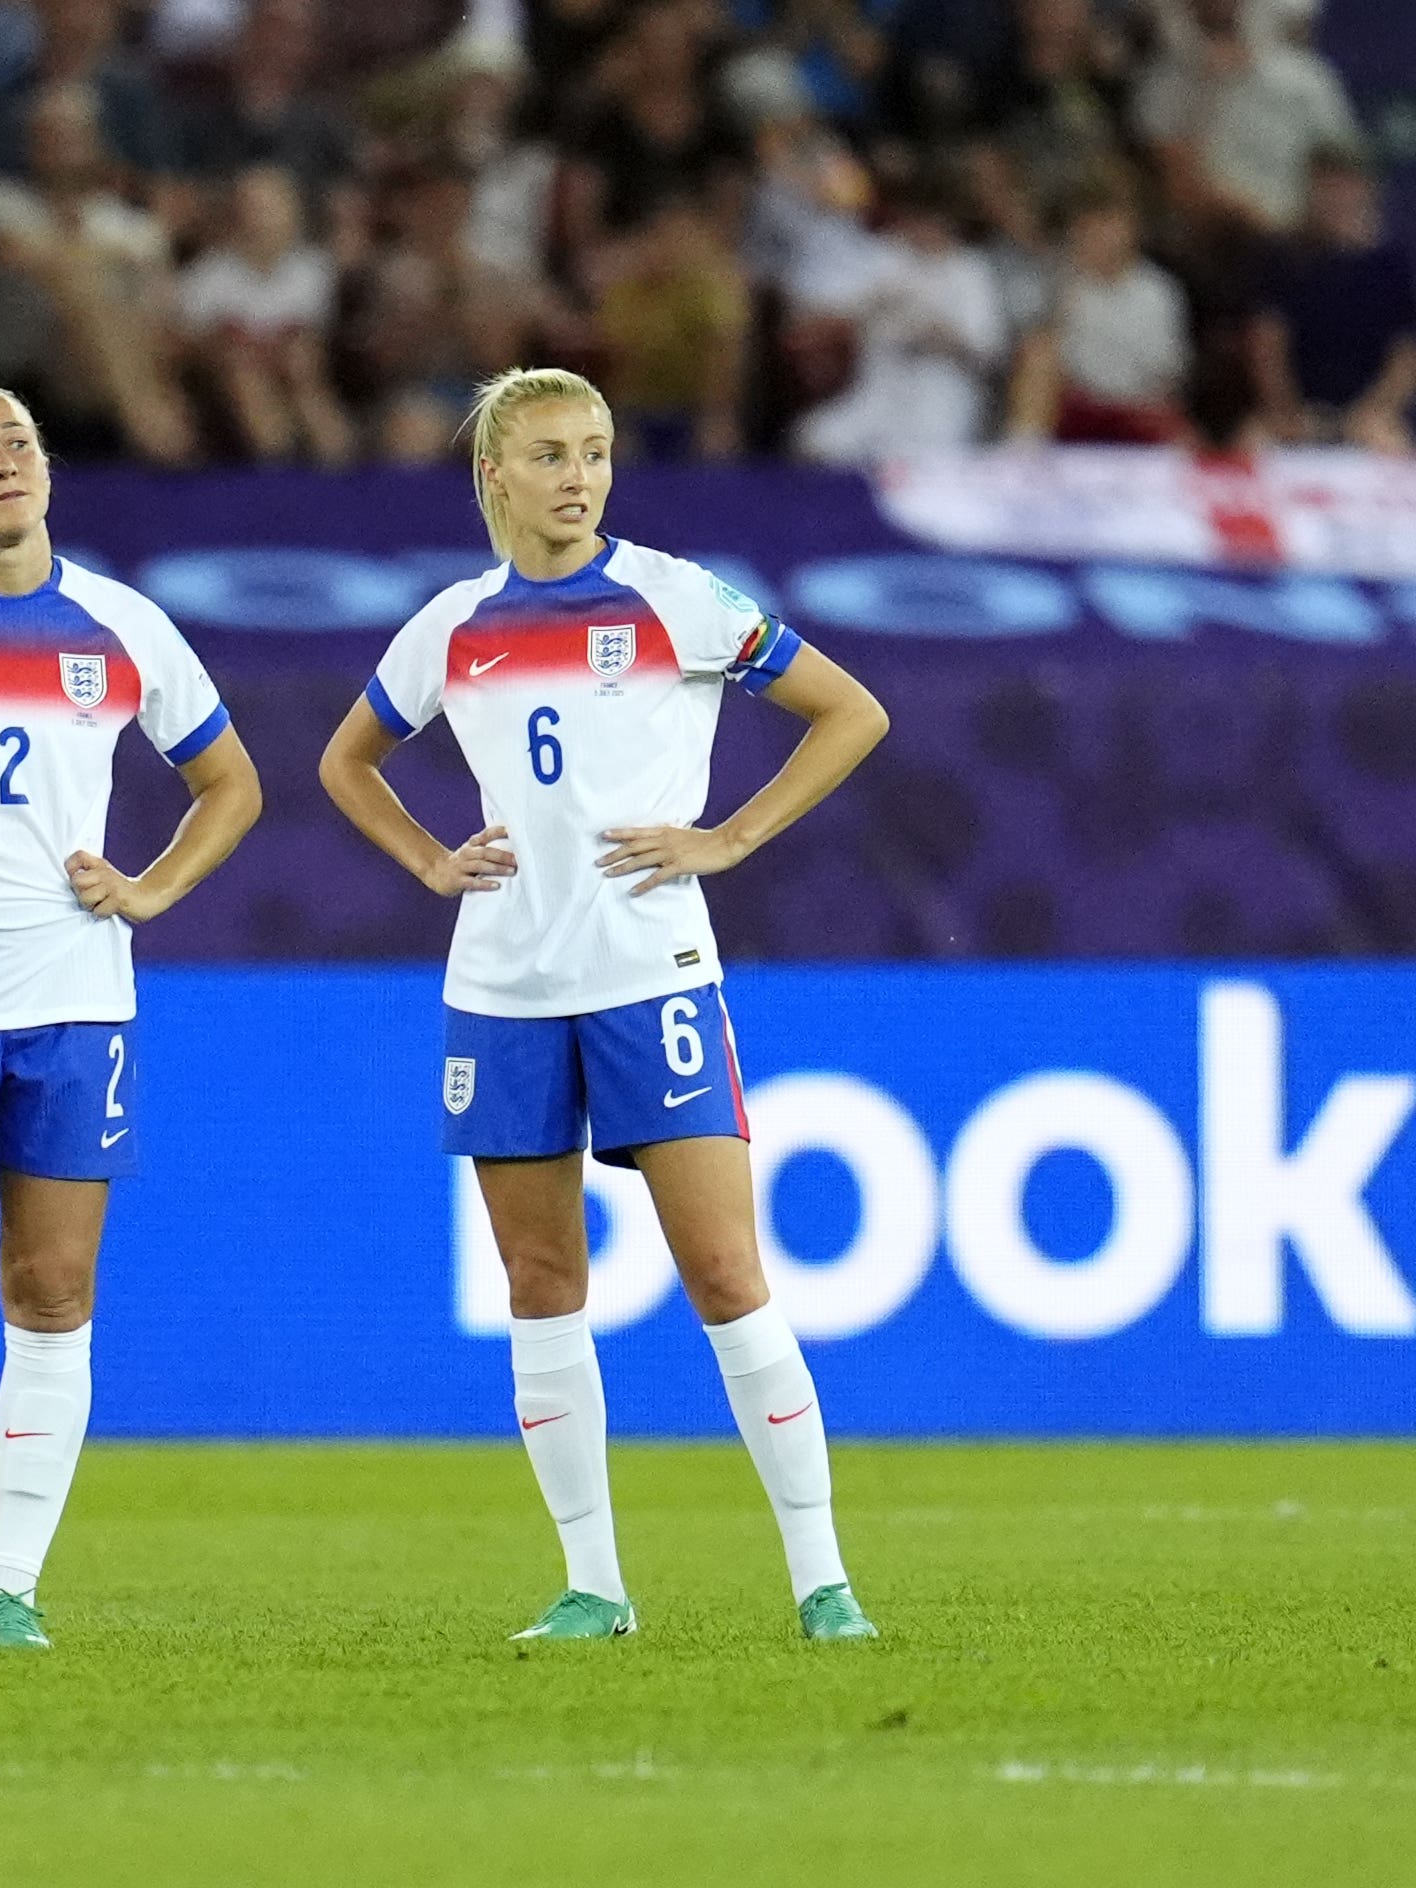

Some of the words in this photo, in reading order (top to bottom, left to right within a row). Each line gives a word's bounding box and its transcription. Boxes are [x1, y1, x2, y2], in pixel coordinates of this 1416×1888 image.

[527, 706, 563, 785] 6
[106, 1034, 125, 1118] 2
[660, 996, 704, 1076] 6
